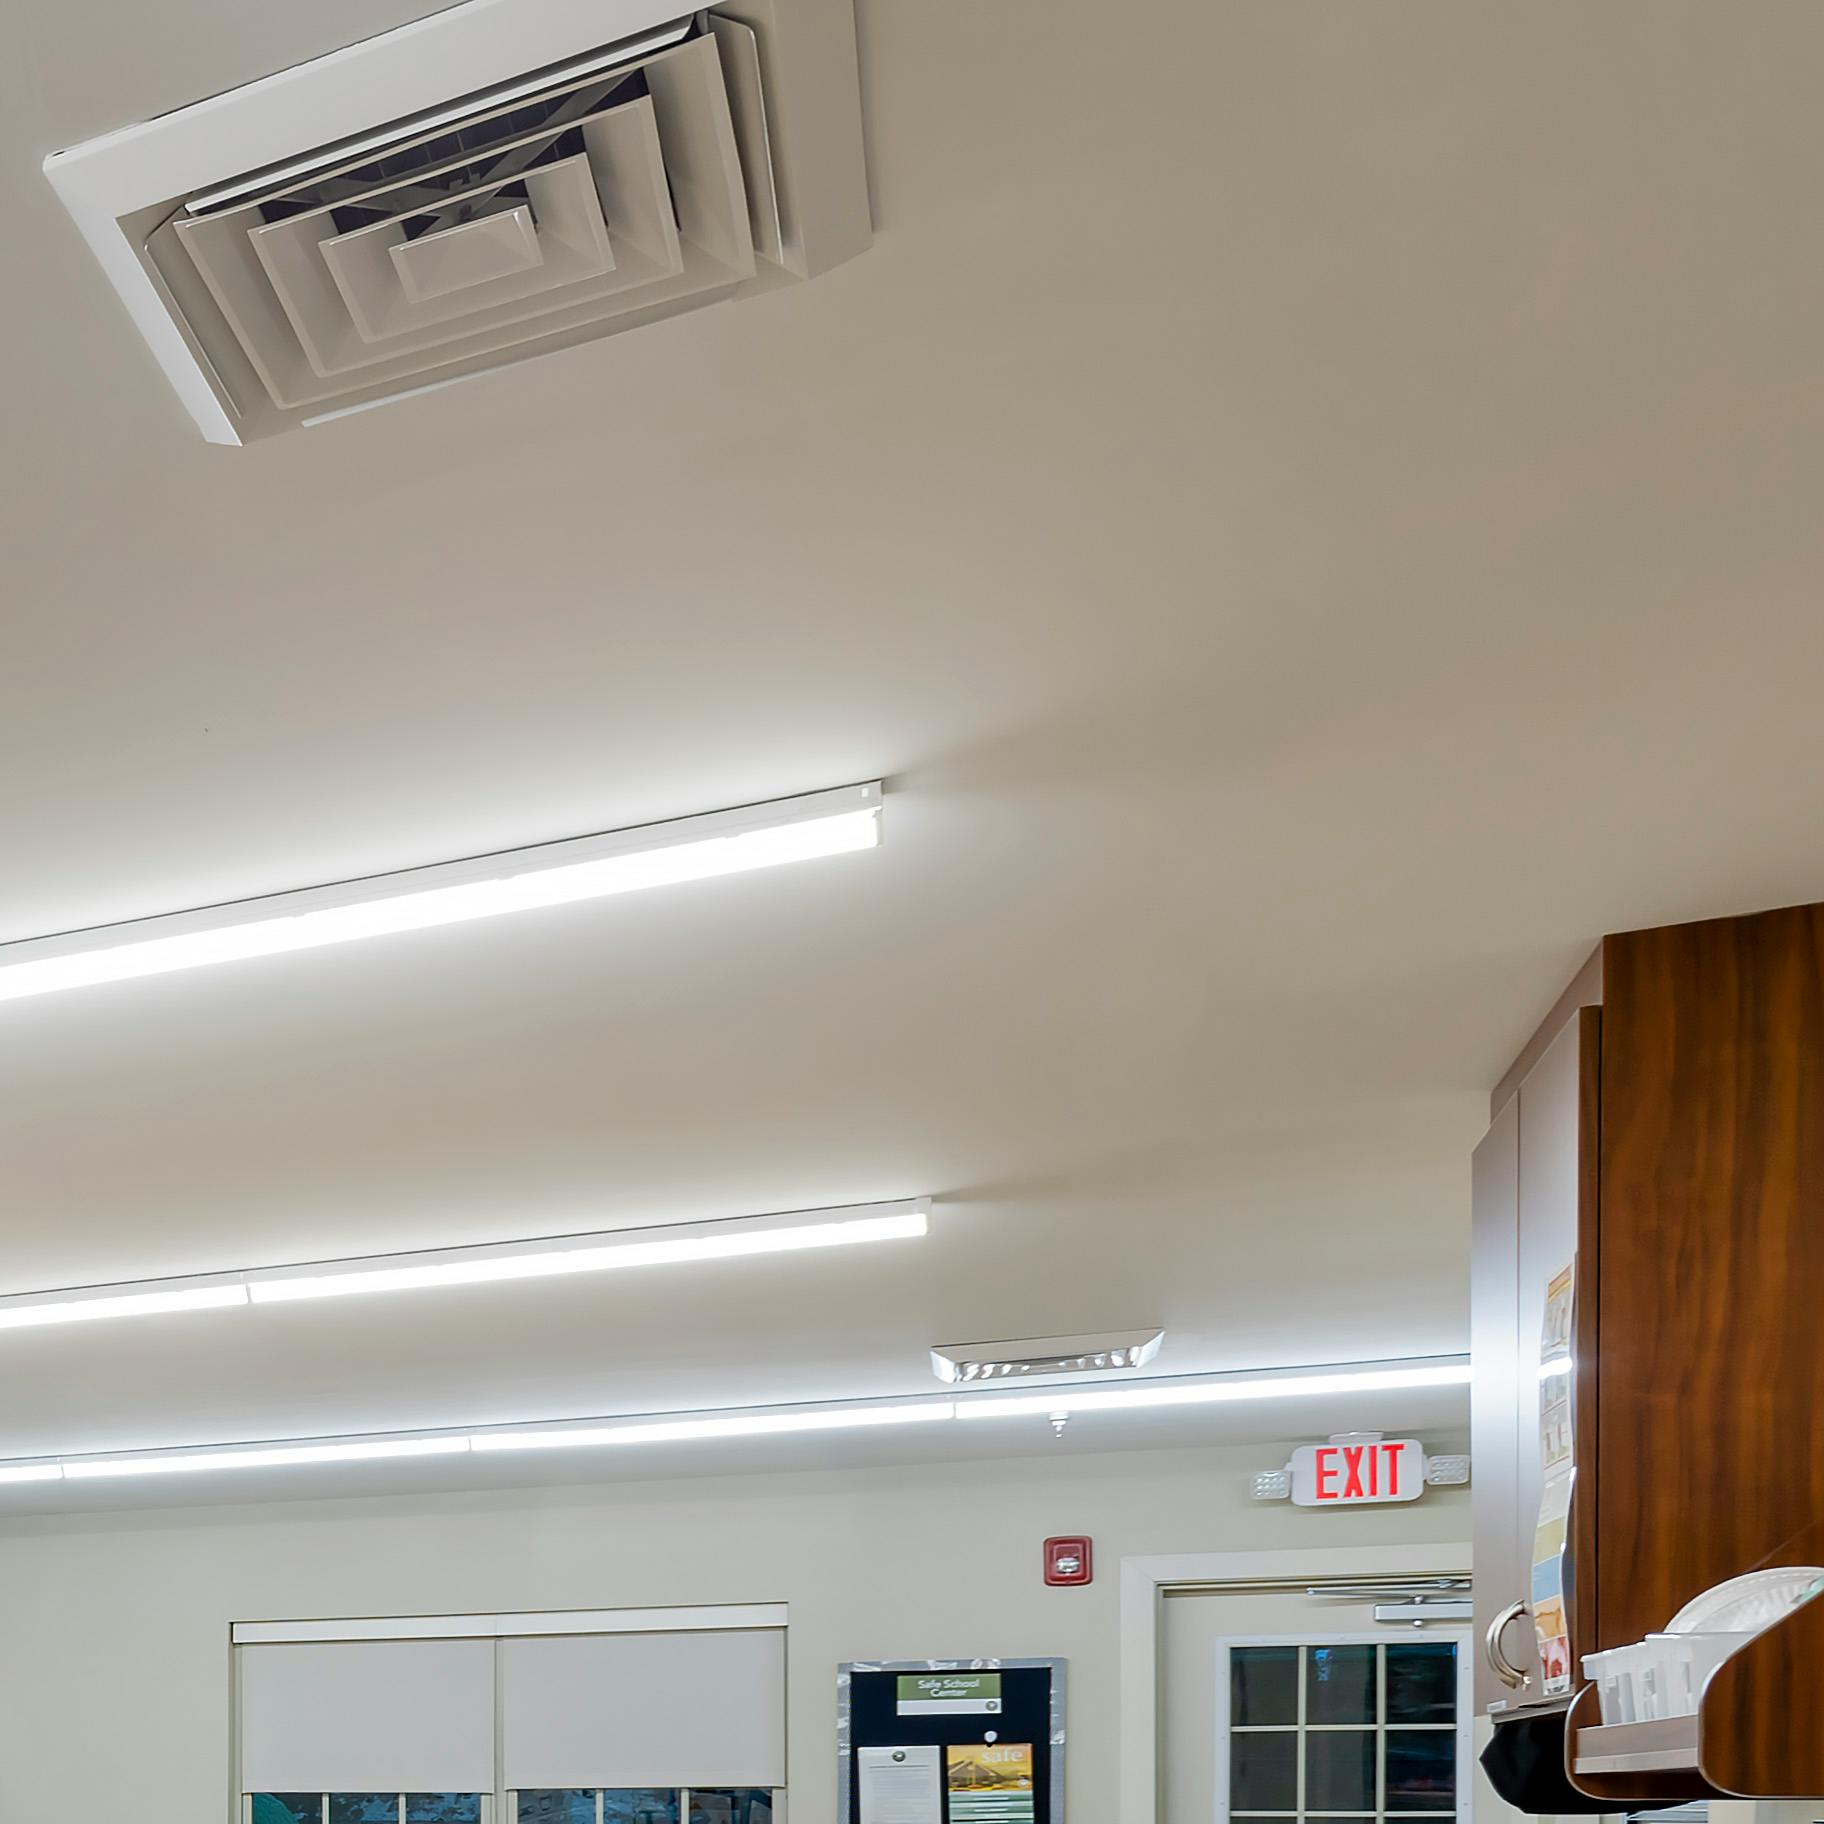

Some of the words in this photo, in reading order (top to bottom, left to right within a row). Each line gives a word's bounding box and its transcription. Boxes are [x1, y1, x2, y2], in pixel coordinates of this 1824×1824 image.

[1315, 1444, 1405, 1499] EXIT
[917, 1679, 942, 1689] Safe
[943, 1678, 980, 1688] School
[930, 1688, 968, 1697] Center
[981, 1749, 1024, 1763] safe
